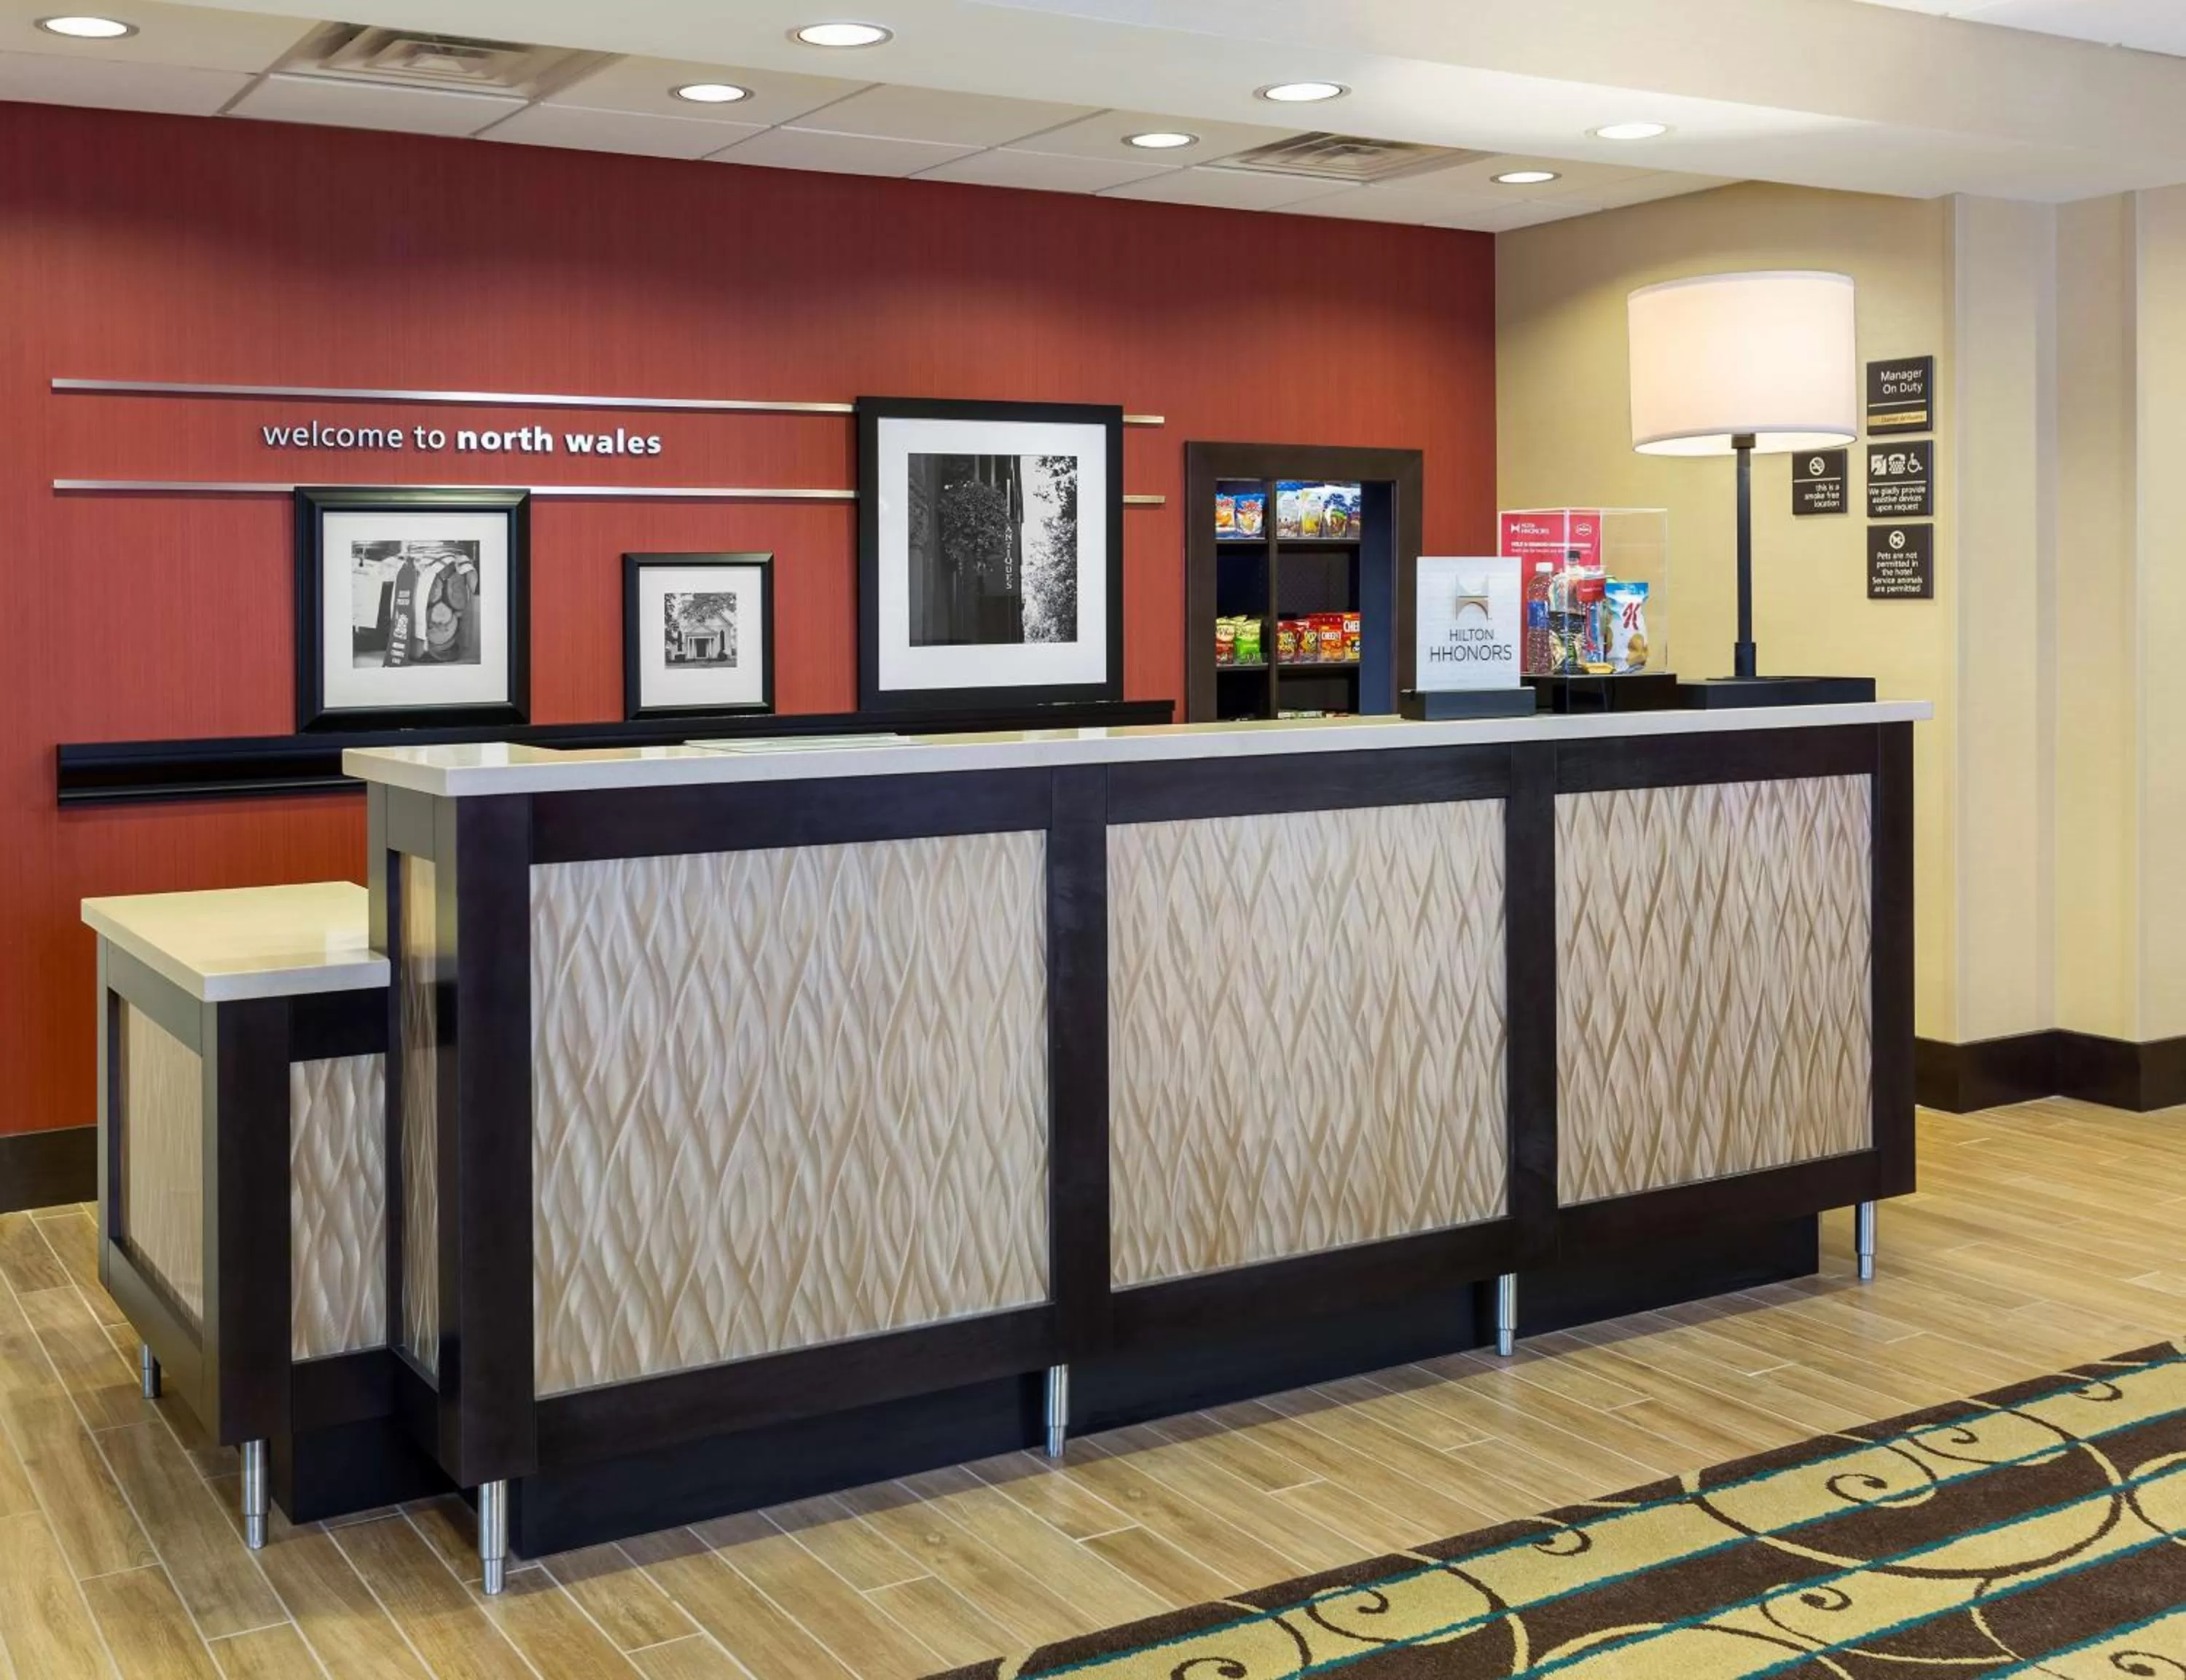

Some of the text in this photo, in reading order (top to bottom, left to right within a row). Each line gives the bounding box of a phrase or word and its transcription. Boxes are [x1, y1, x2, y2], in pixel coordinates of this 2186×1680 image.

[1881, 369, 1923, 382] Manager
[1882, 382, 1923, 394] On Duty
[263, 420, 662, 455] welcome to north wales
[1815, 484, 1827, 492] this
[1868, 485, 1926, 498] We gladly provide
[1827, 491, 1840, 499] free
[1814, 500, 1840, 508] location
[1875, 503, 1919, 513] upon request
[1876, 552, 1891, 560] Pets
[1905, 552, 1917, 560] not
[1876, 559, 1919, 569] permitted in
[1881, 568, 1894, 576] the
[1872, 576, 1923, 584] Service animals
[1887, 584, 1921, 594] permitted
[1449, 629, 1494, 642] HILTON
[1430, 645, 1513, 662] HHONORS
